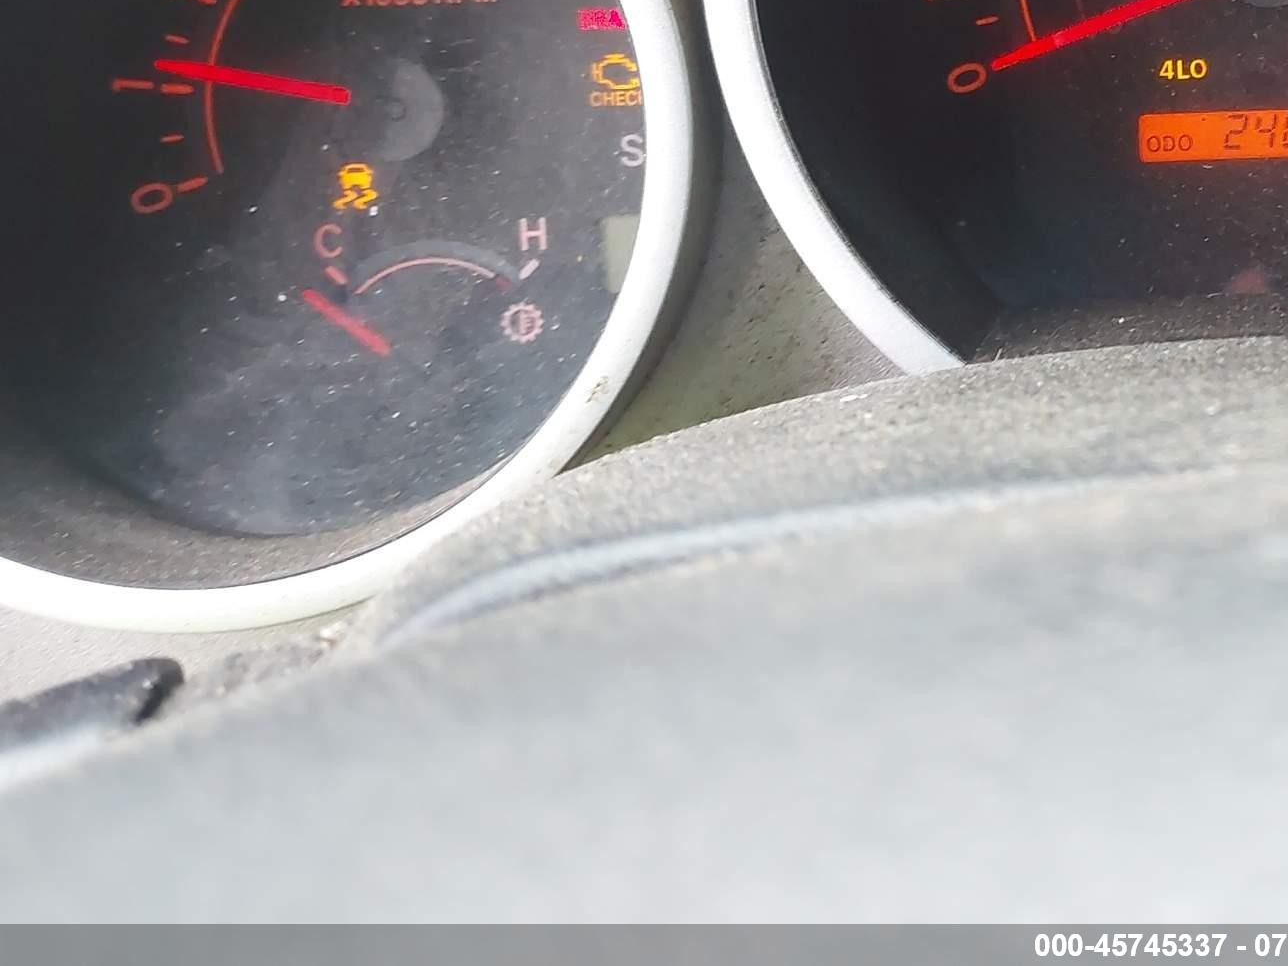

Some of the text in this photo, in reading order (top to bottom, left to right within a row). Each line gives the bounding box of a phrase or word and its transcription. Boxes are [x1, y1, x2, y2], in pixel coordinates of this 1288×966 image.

[947, 61, 988, 94] 0
[1159, 59, 1208, 80] 4LO
[111, 78, 154, 94] 1
[1146, 134, 1194, 153] ODO
[129, 181, 172, 214] 0
[314, 223, 343, 258] C
[519, 219, 548, 251] H
